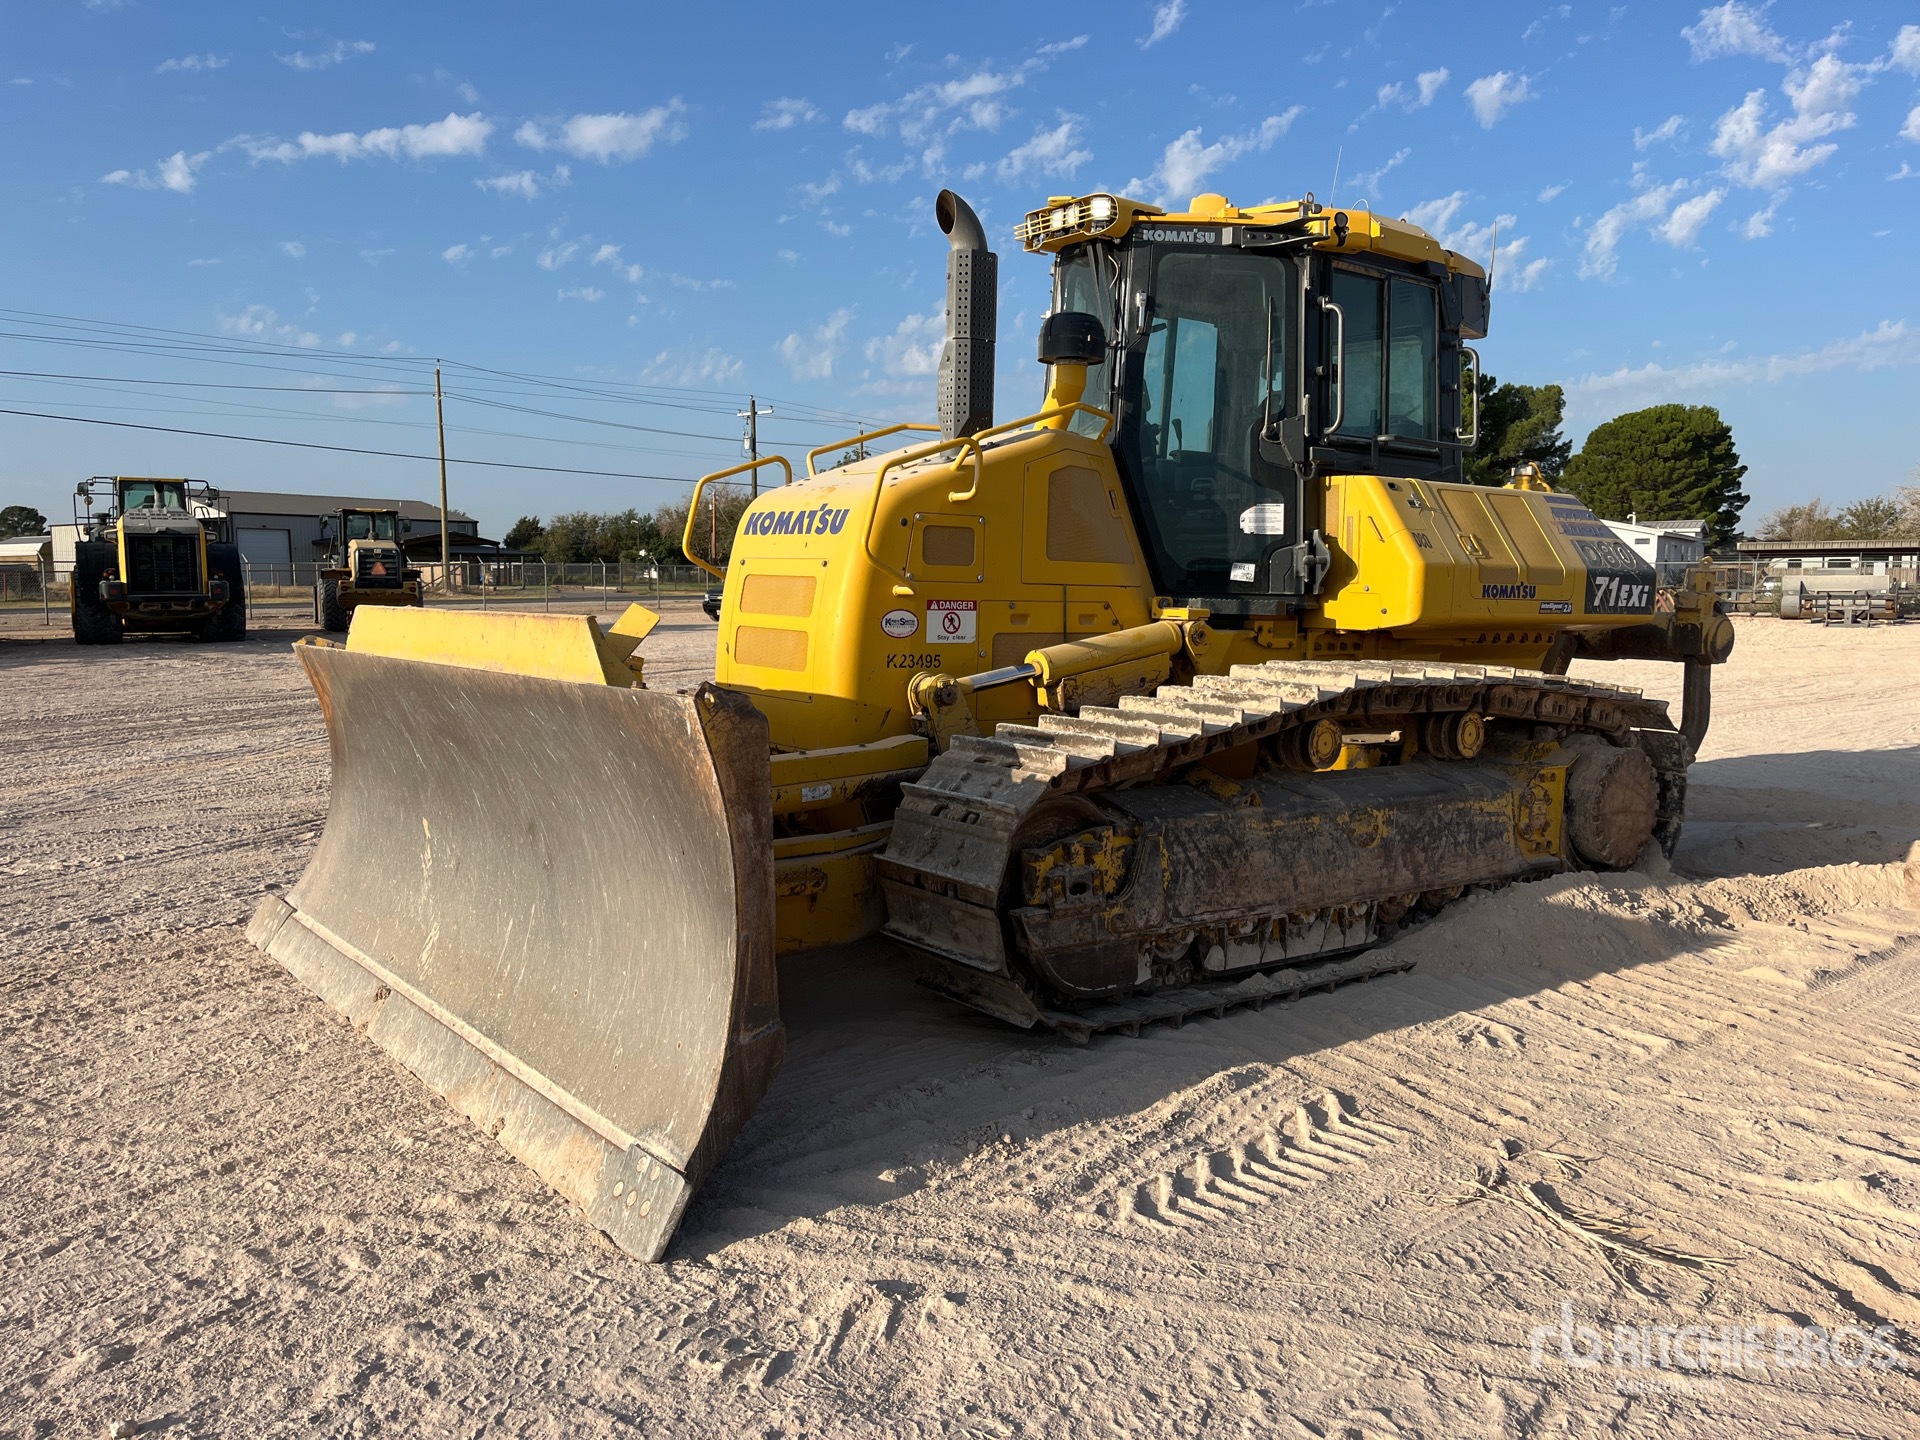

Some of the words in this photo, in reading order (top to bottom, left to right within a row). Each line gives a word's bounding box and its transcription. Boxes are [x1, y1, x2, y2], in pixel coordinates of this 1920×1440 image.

[1143, 228, 1216, 244] KOMATSU
[743, 503, 850, 536] KOMATSU
[1482, 581, 1537, 599] KOMATSU
[1593, 576, 1650, 608] 71EXi
[939, 601, 974, 610] DANGER
[886, 653, 942, 669] K23495
